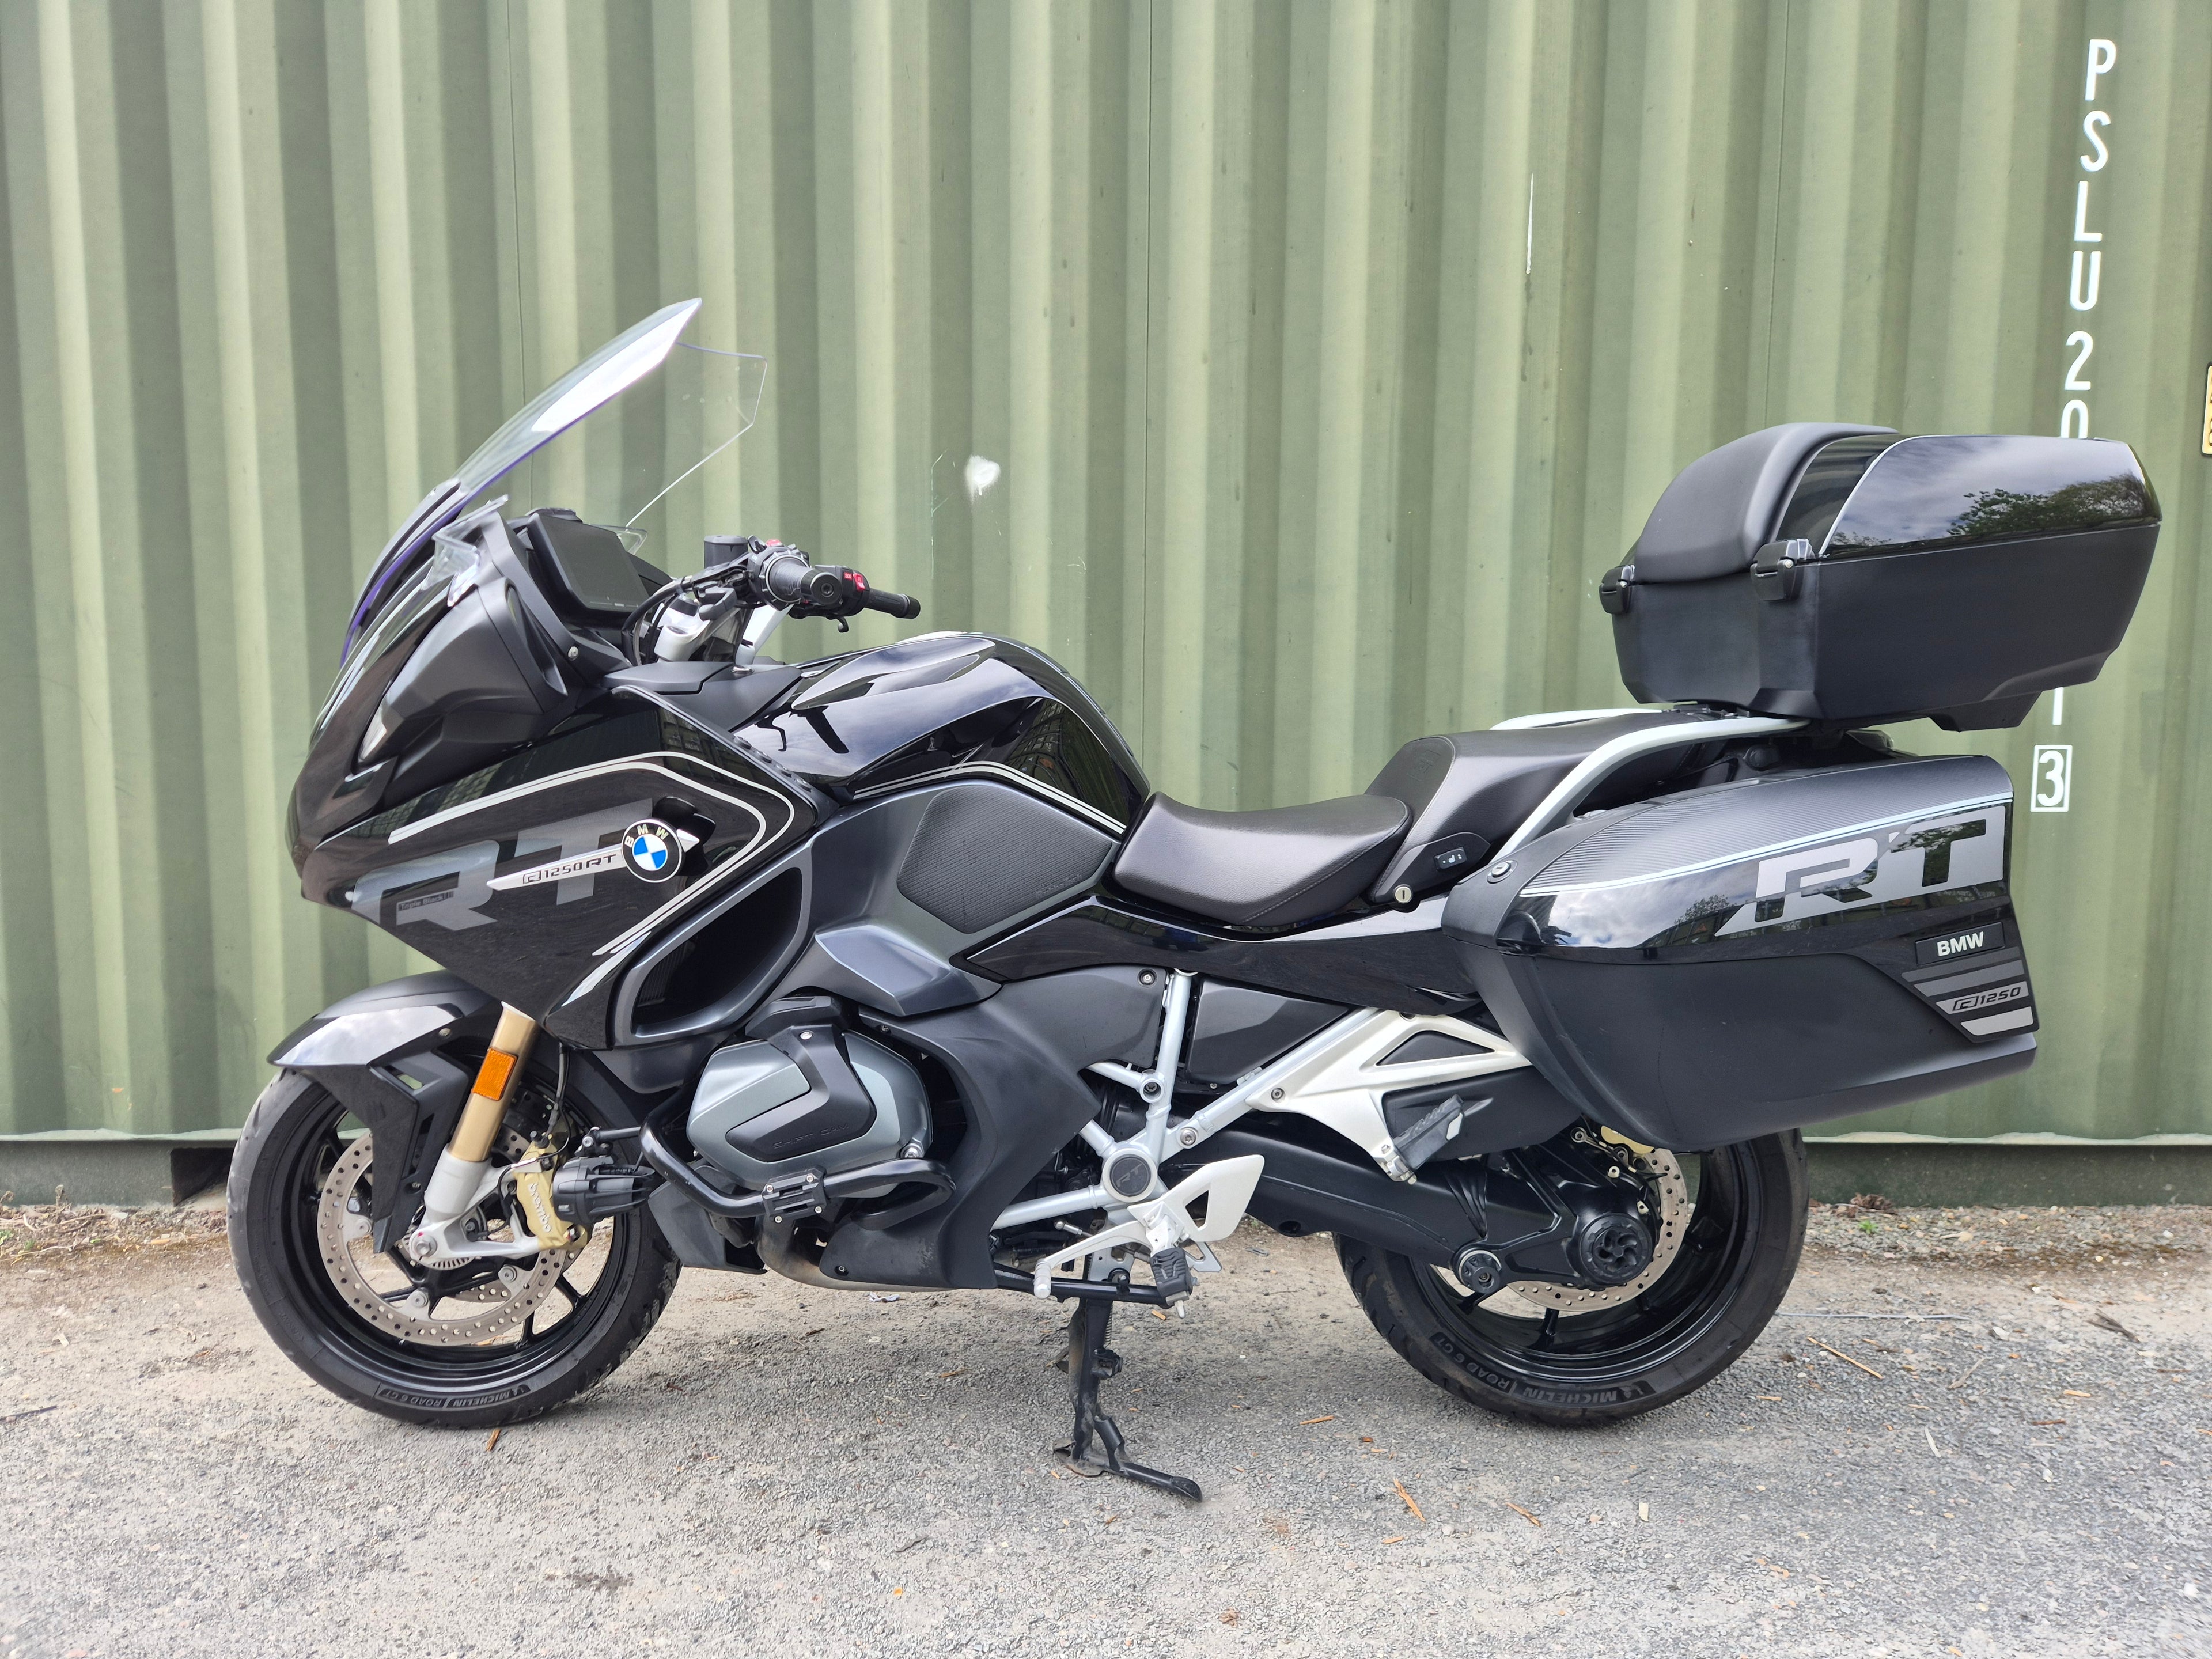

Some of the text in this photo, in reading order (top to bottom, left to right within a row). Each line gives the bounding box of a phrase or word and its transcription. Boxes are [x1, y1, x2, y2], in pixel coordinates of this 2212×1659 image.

[2037, 750, 2065, 807] 3
[624, 824, 669, 848] BMW
[1755, 818, 1987, 923] RT
[1937, 931, 1984, 957] BMW
[773, 1123, 849, 1149] SHIFT CAM
[1116, 1163, 1142, 1188] RT
[1467, 1362, 1510, 1390] ROAD
[410, 1396, 443, 1407] ROAD
[453, 1390, 512, 1407] MICHELIN
[1522, 1386, 1617, 1403] MICHELIN
